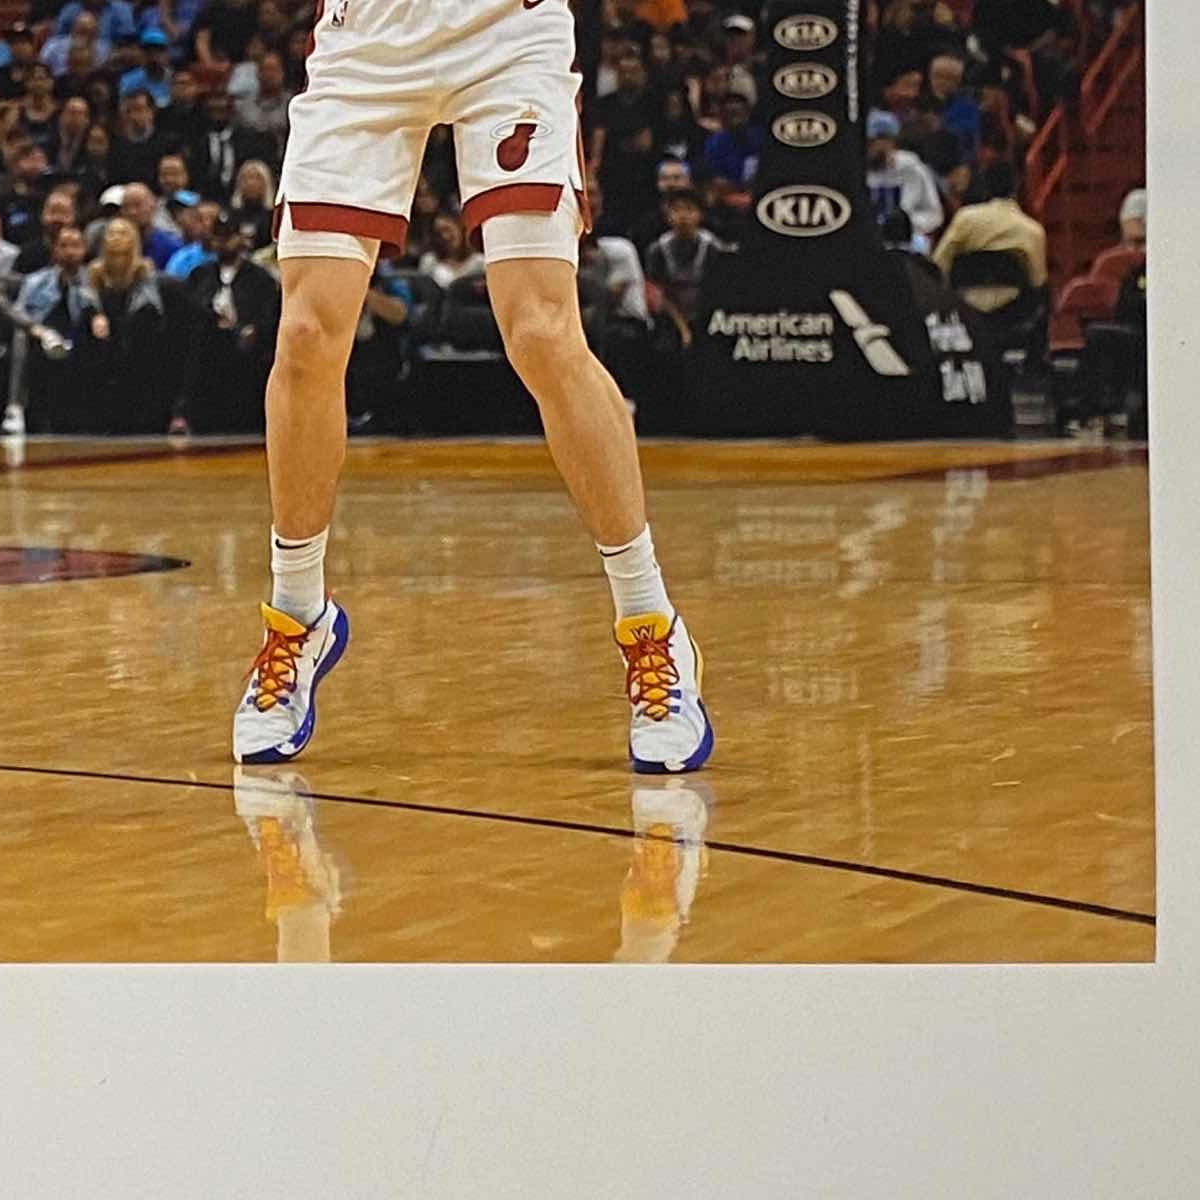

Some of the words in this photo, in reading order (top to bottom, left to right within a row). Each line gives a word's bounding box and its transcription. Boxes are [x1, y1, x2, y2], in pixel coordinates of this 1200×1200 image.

[772, 195, 837, 227] KIA
[707, 309, 834, 336] American
[732, 336, 834, 362] Airlines
